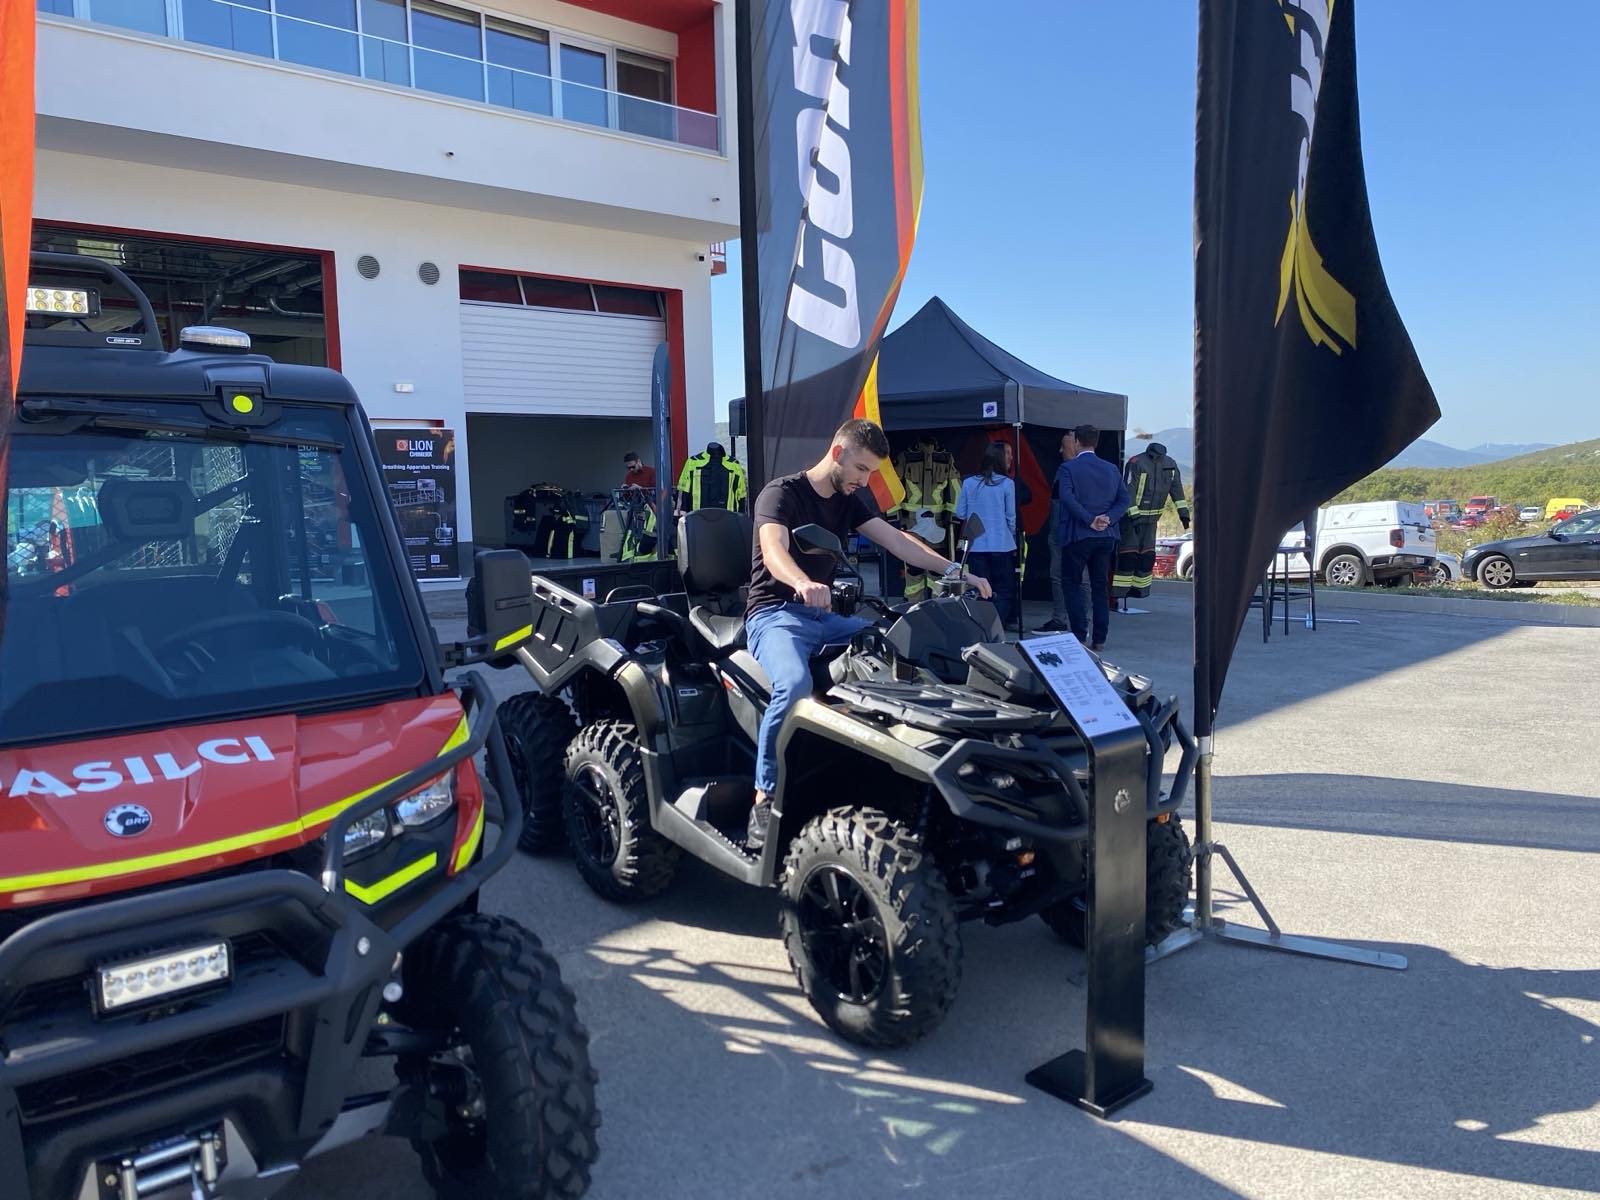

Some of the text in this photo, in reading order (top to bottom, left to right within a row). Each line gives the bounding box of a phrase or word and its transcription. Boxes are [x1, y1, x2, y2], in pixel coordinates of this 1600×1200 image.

[409, 440, 433, 451] LION
[0, 736, 275, 798] ASILCI
[125, 816, 150, 827] BRP
